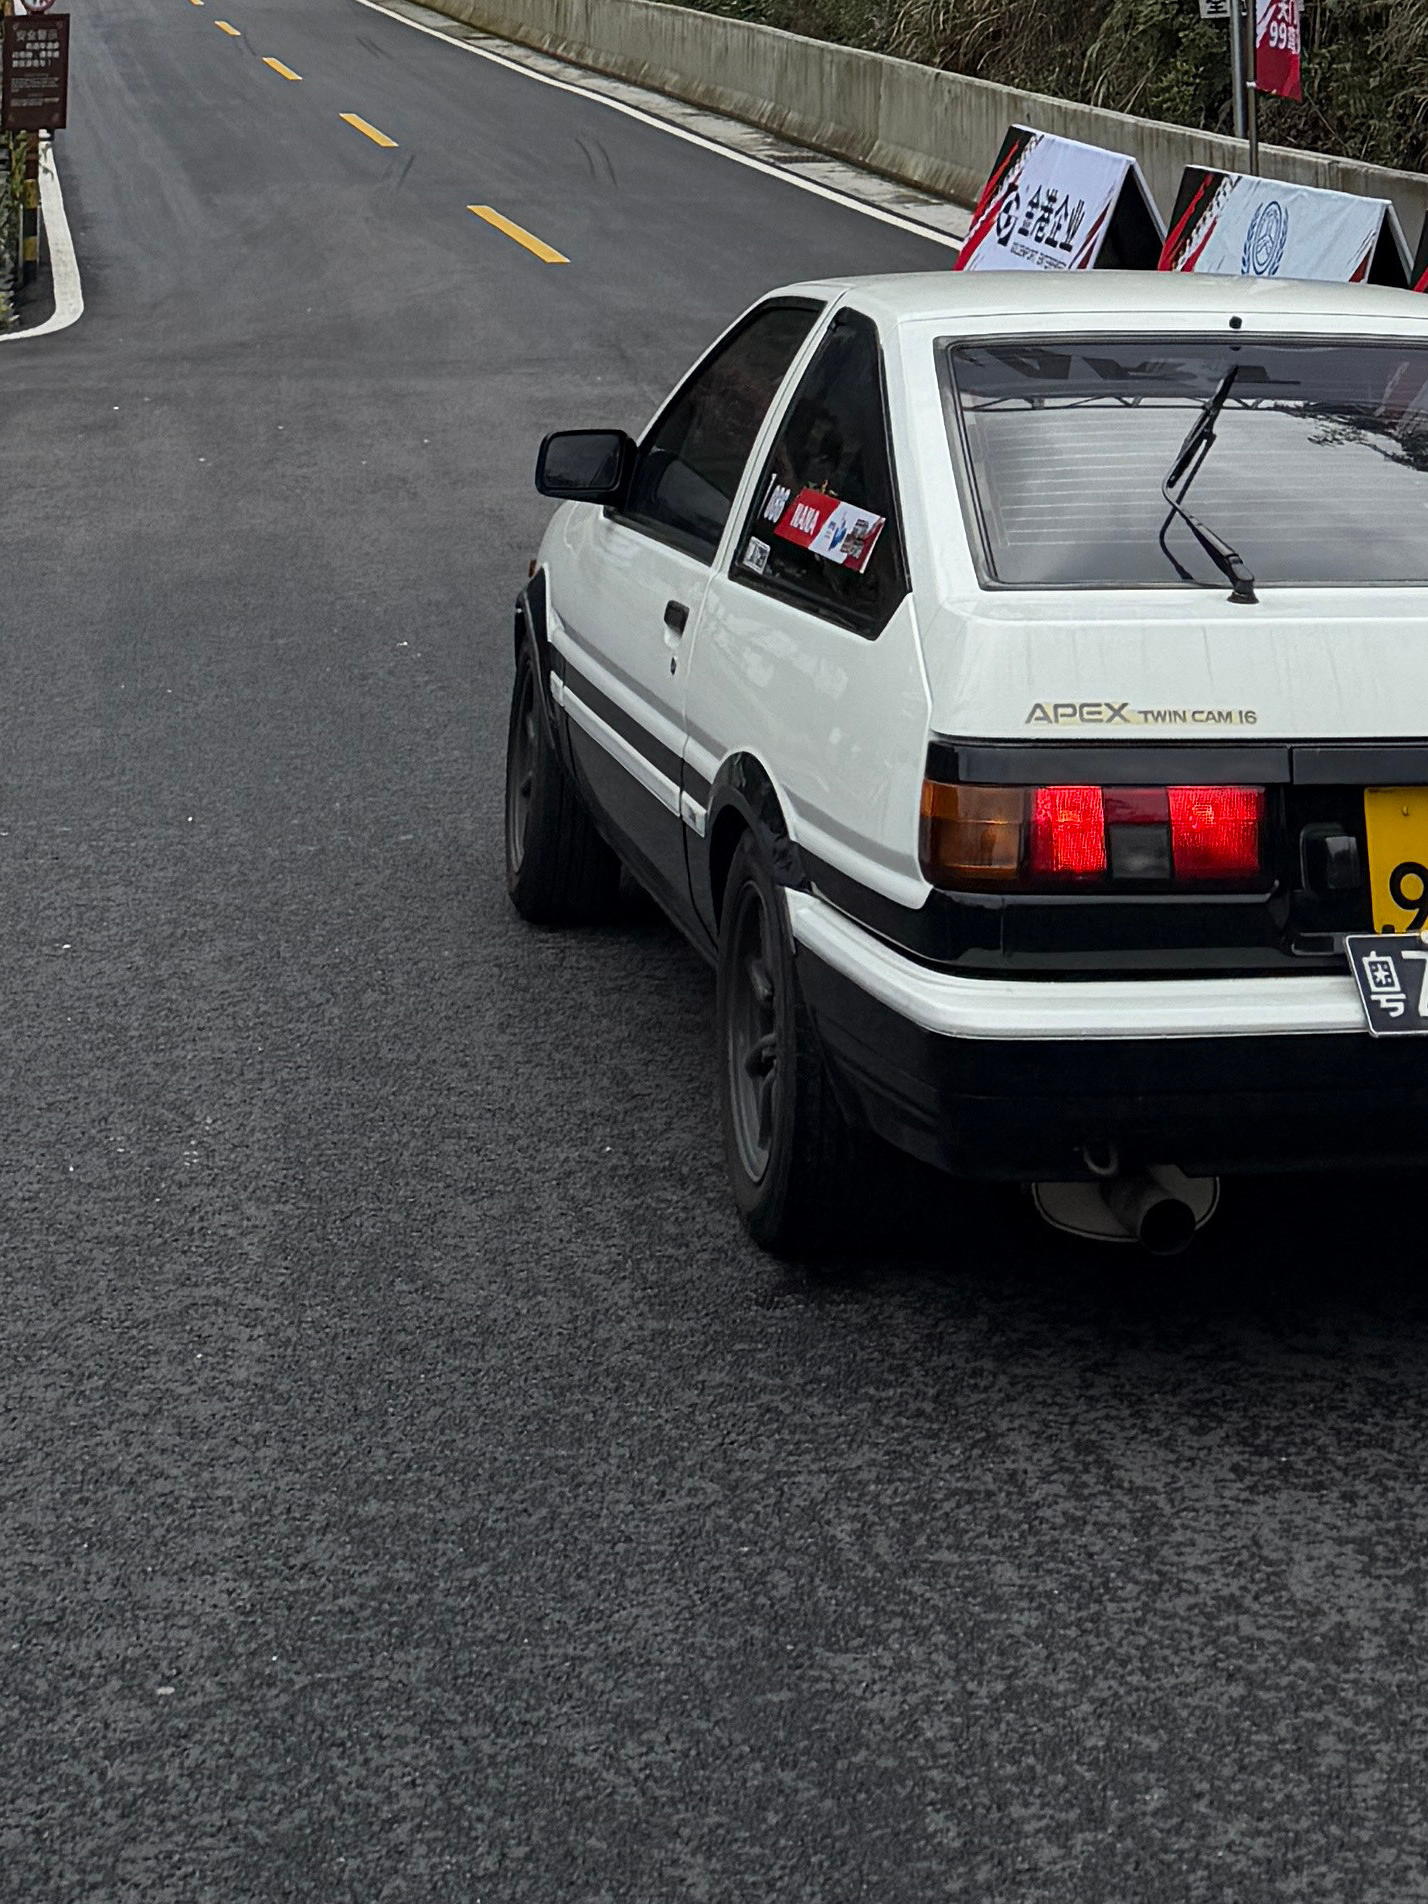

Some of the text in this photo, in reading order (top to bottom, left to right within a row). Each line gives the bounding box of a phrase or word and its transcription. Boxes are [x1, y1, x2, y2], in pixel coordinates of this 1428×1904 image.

[1024, 702, 1131, 724] APEX
[1138, 709, 1187, 724] TWIN
[1191, 709, 1233, 724] CAM
